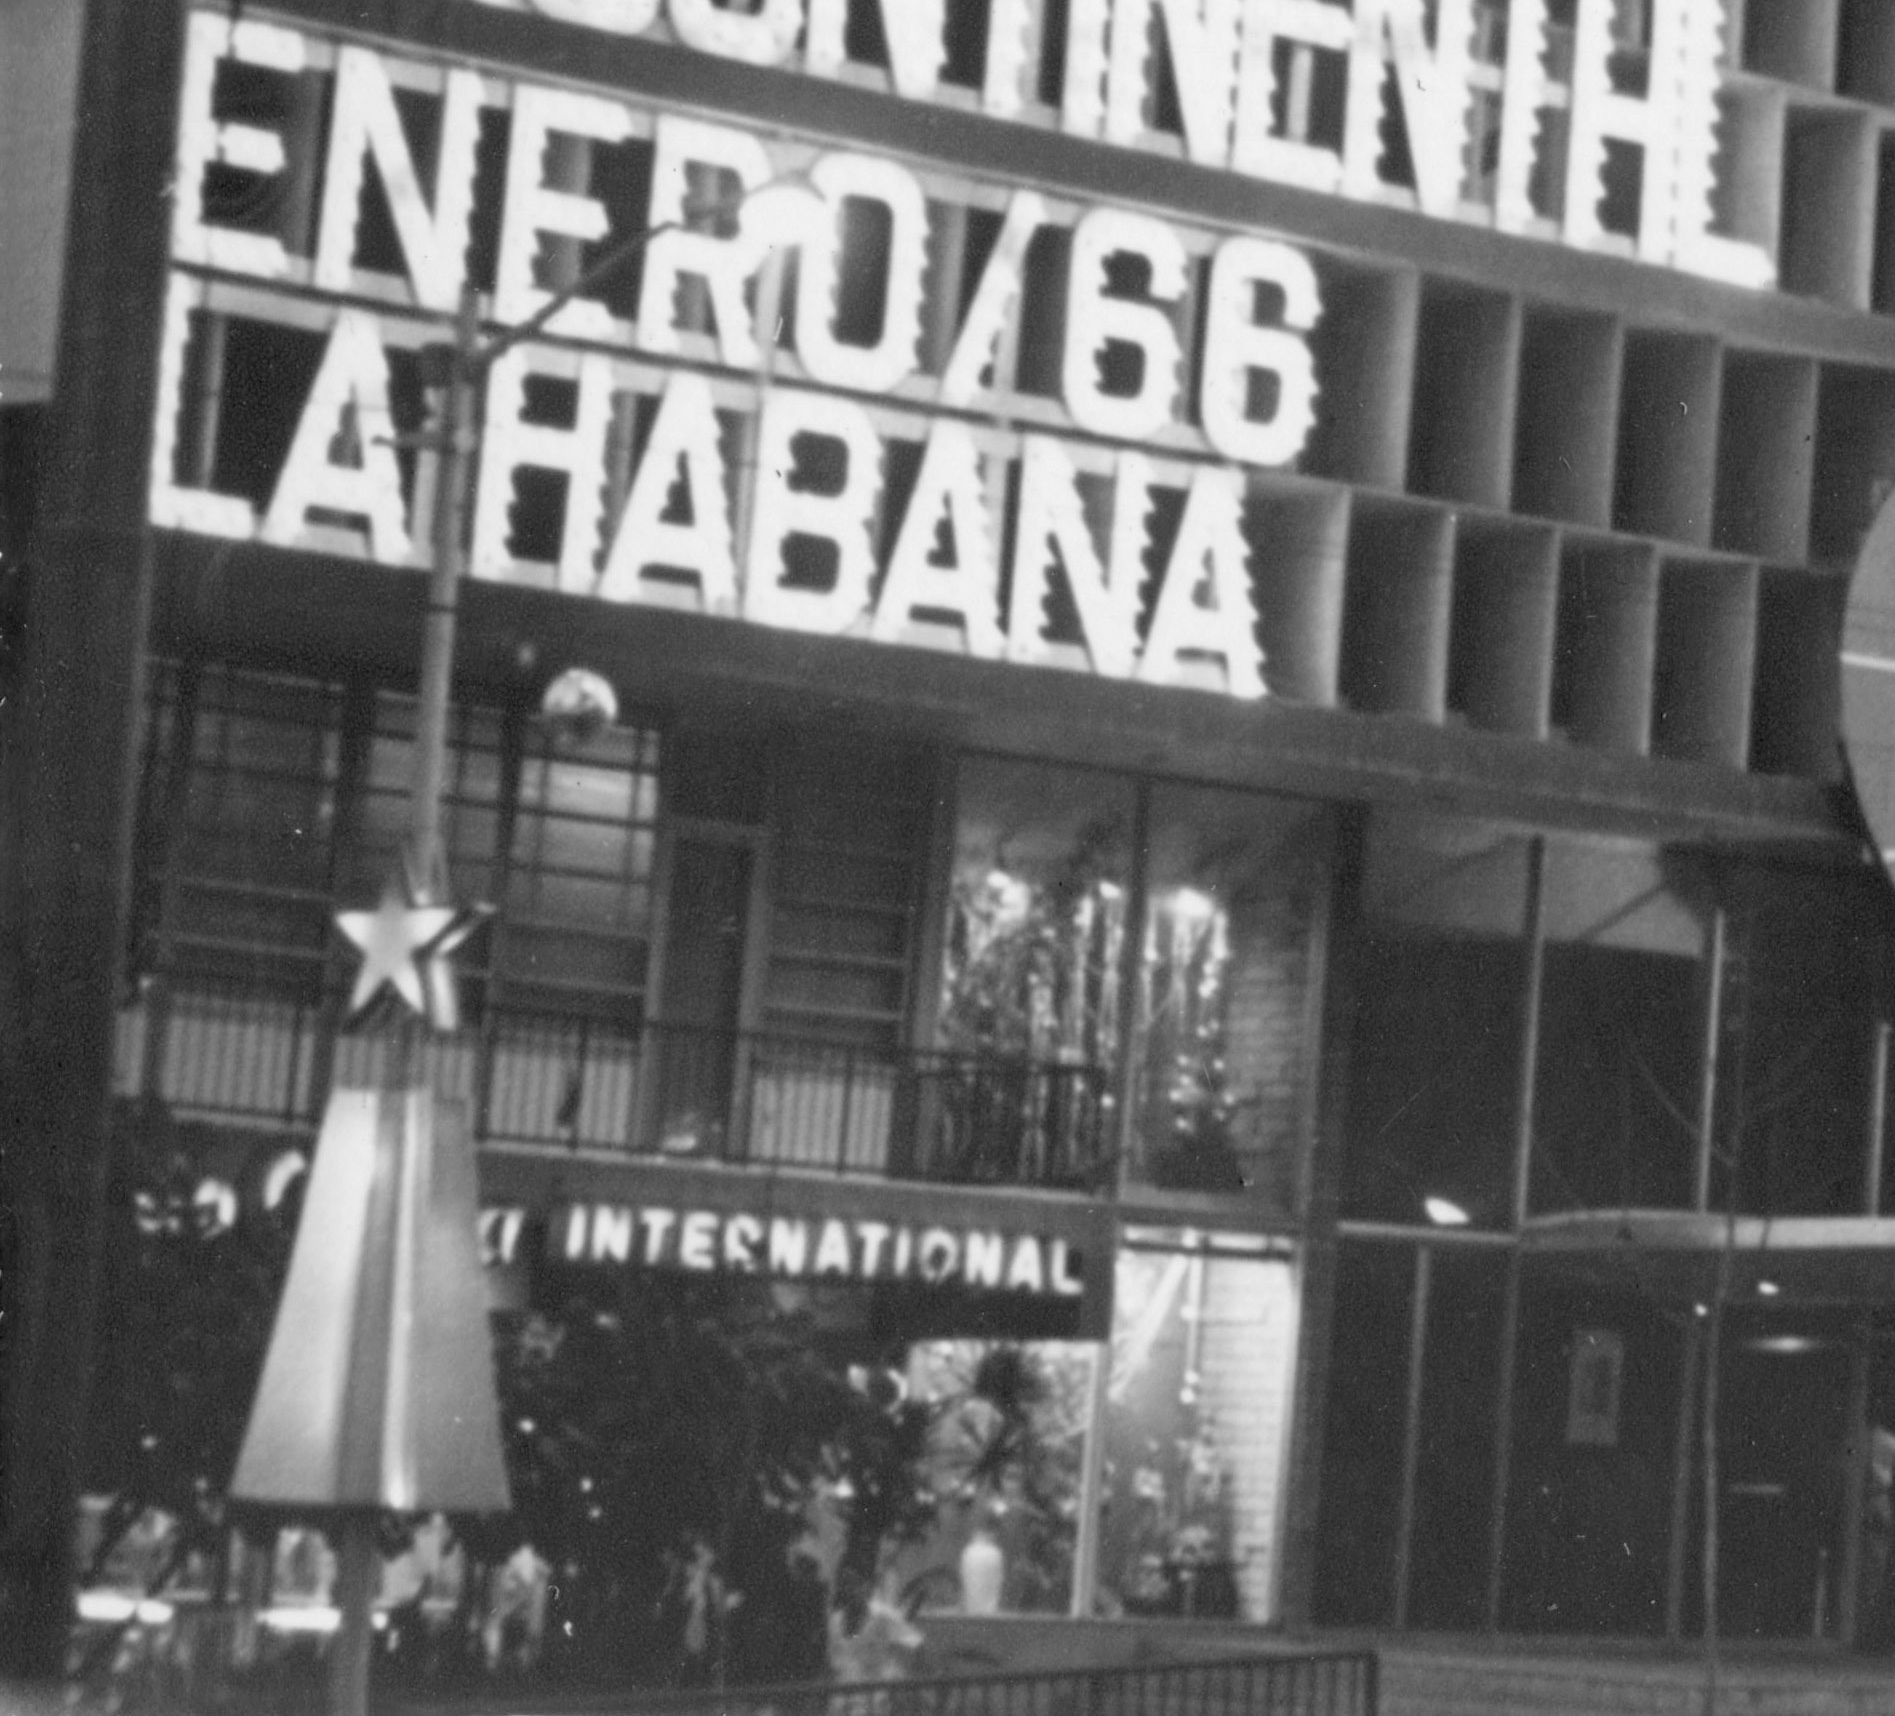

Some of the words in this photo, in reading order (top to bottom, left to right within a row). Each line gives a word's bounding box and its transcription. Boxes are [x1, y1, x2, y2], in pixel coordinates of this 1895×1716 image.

[166, 9, 1324, 466] ENERO/66
[148, 270, 414, 568] LA
[470, 338, 1270, 700] HABANA
[565, 1202, 1085, 1296] INTERNATIONAL
